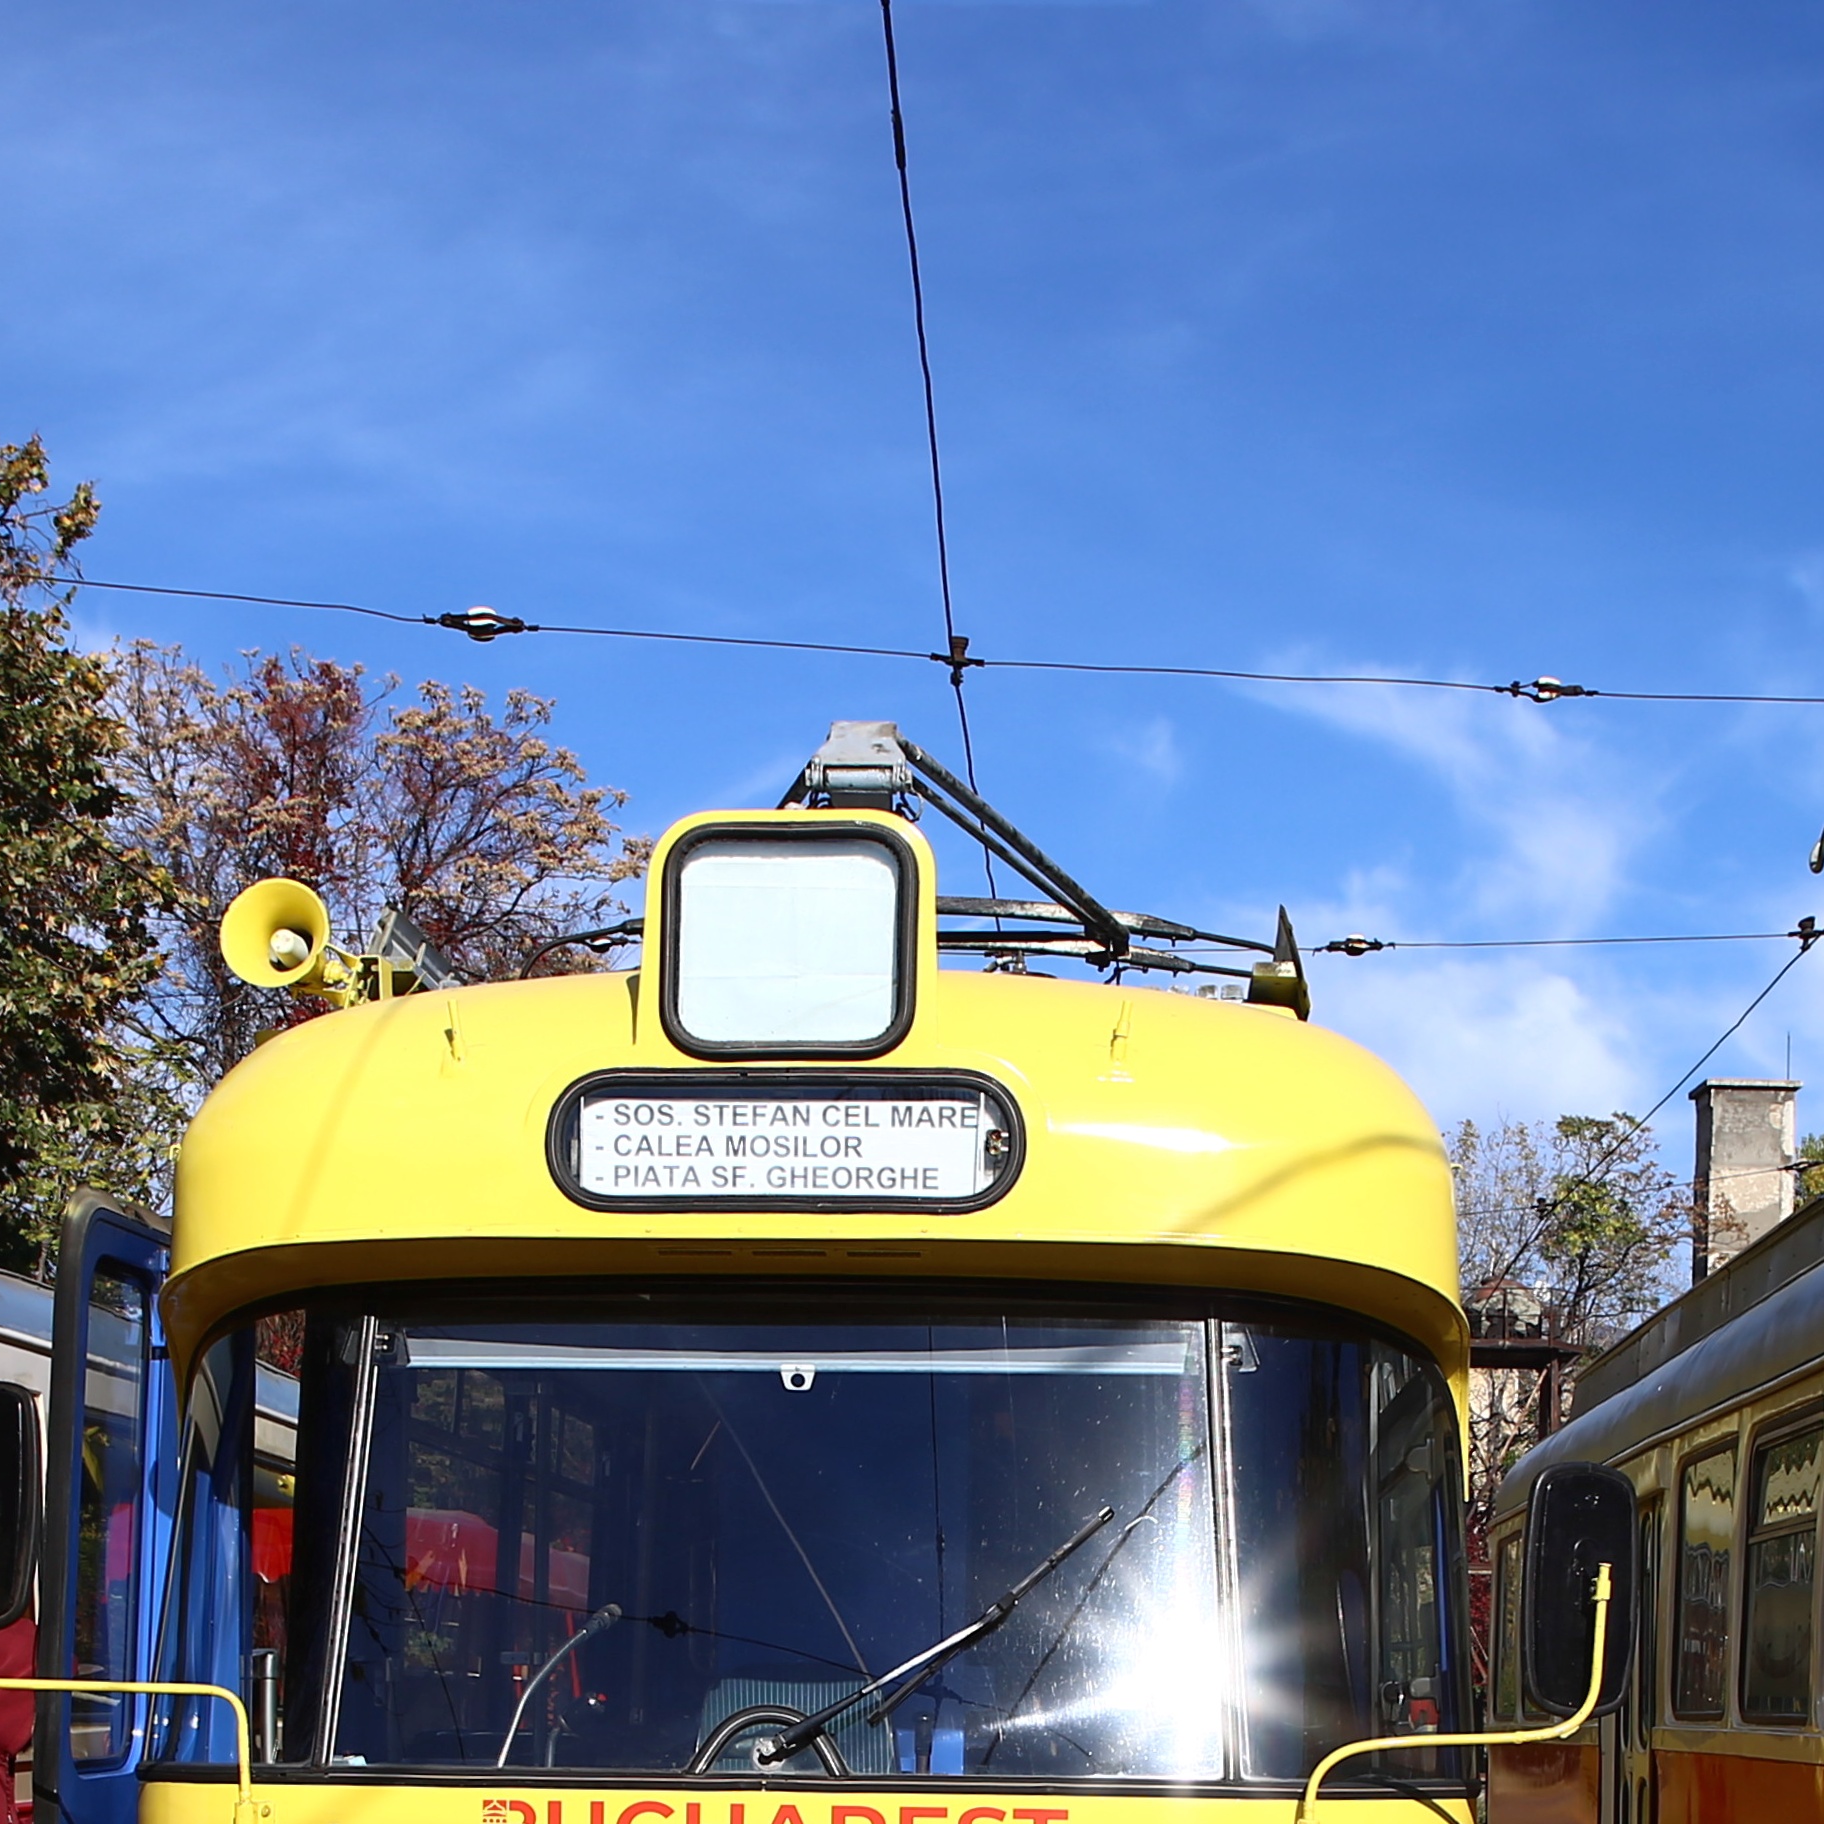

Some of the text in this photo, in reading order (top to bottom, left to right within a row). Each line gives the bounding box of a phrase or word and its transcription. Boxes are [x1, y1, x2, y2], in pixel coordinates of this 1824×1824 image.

[613, 1104, 683, 1127] SOS.
[693, 1104, 811, 1129] STEFAN
[821, 1105, 880, 1129] CEL
[890, 1106, 978, 1130] MARE
[613, 1135, 715, 1158] CALEA
[725, 1136, 863, 1159] MOSILOR
[614, 1166, 702, 1189] PIATA
[711, 1166, 755, 1189] SF.
[766, 1166, 940, 1191] GHEORGHE
